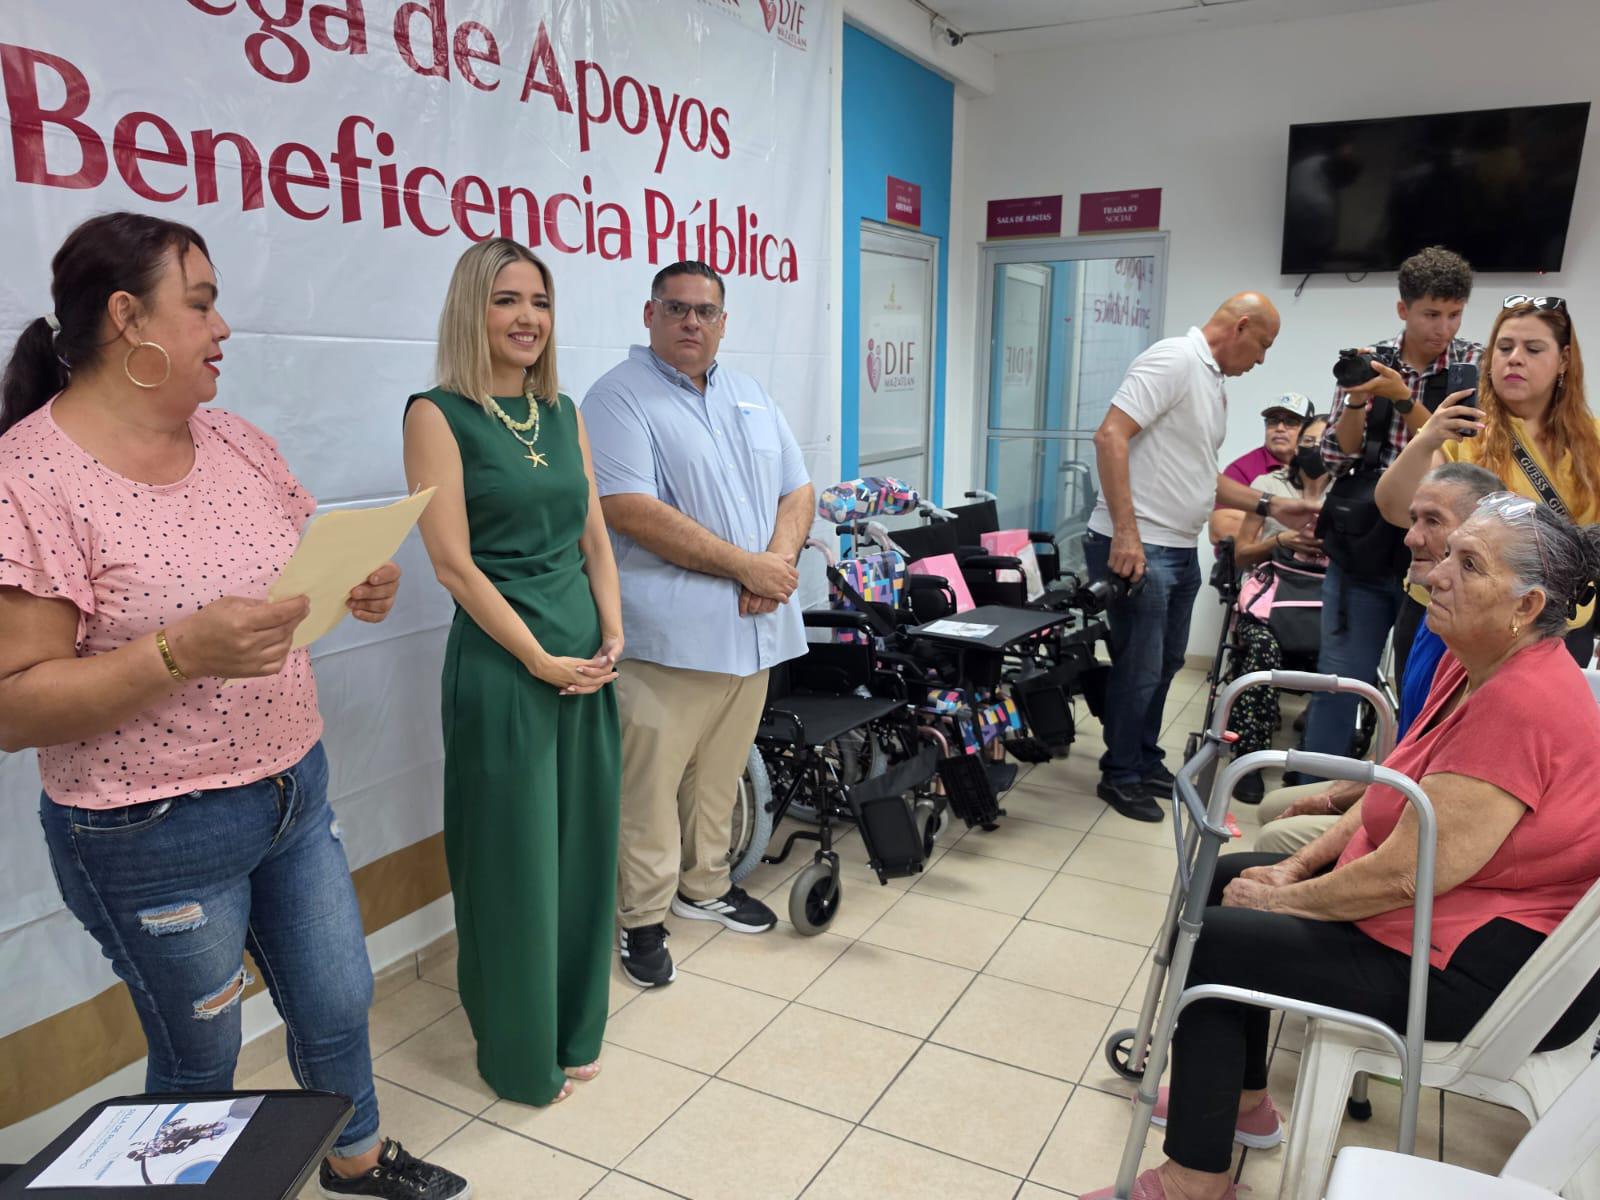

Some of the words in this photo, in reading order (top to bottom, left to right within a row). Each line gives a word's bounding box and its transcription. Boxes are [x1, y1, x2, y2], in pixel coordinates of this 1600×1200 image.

[778, 0, 805, 35] DIF
[187, 0, 368, 84] ga
[394, 0, 501, 91] de
[520, 19, 731, 174] Apoyos
[0, 42, 633, 261] Beneficencia
[644, 188, 799, 283] Pública
[996, 215, 1015, 224] SALA
[1015, 215, 1024, 223] DE
[1026, 213, 1052, 223] JUNTAS
[1103, 204, 1138, 215] TRABAJO
[885, 341, 915, 375] DIF
[1520, 457, 1549, 491] GUESS
